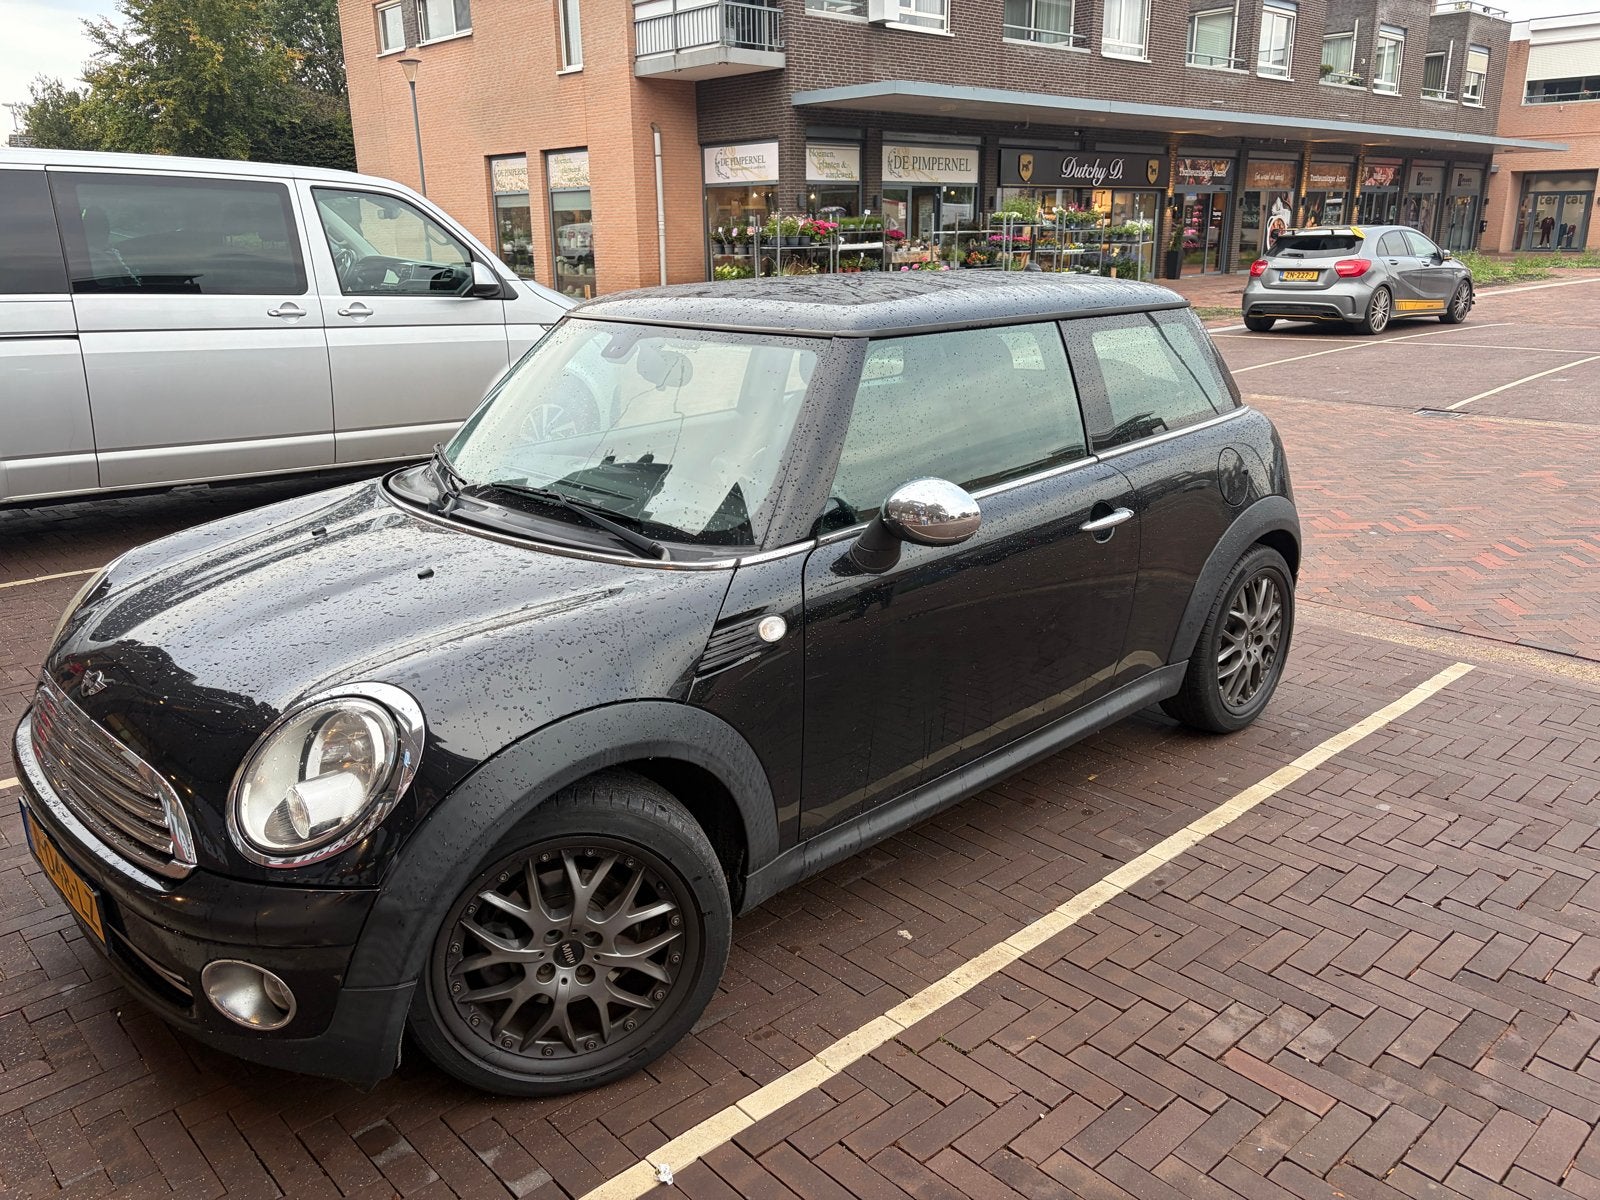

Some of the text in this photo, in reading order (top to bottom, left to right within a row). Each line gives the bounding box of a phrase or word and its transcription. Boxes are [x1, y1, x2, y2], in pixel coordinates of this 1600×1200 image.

[720, 155, 766, 166] DE PIMPERNEL
[894, 155, 971, 172] DE PIMPERNEL
[1061, 156, 1125, 186] Dutchy D.
[562, 943, 576, 964] MINI
